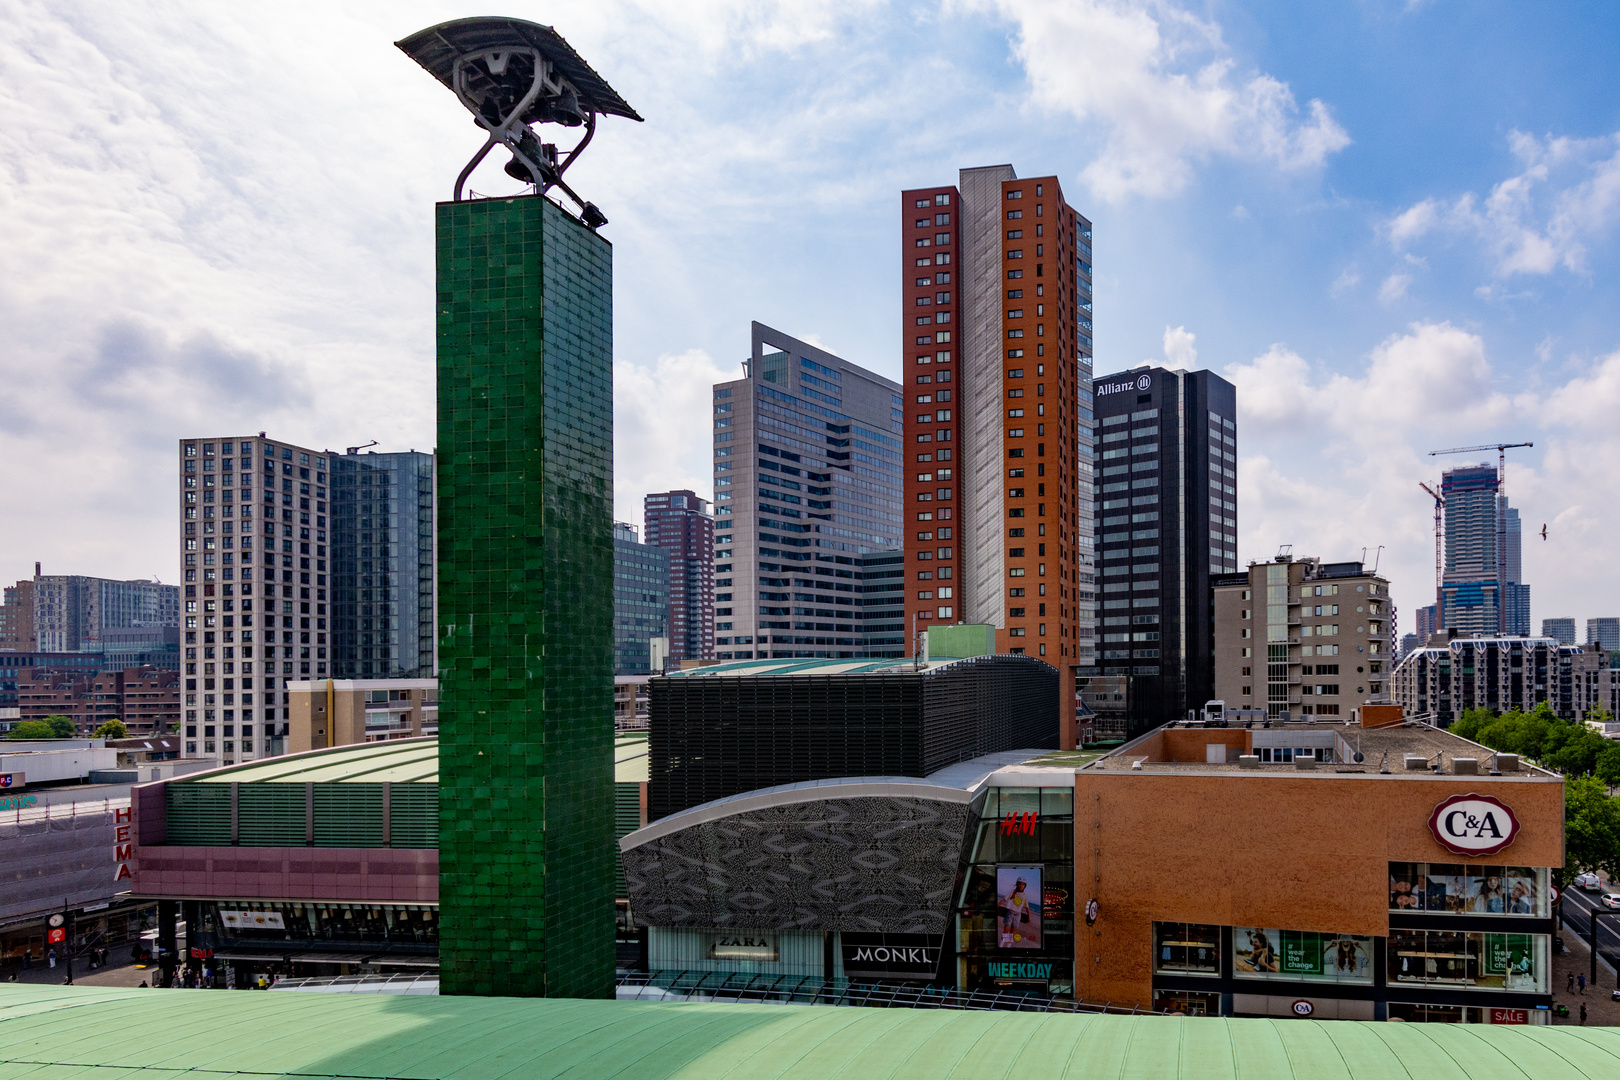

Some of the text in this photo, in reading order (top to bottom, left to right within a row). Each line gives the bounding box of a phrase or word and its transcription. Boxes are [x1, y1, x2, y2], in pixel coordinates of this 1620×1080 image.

[1097, 381, 1134, 397] Allianz
[1000, 811, 1037, 837] H&M
[1445, 810, 1503, 838] C&A
[113, 807, 132, 881] HEMA
[719, 936, 768, 948] ZARA
[852, 947, 932, 963] MONKI
[988, 962, 1053, 979] WEEKDAY
[1287, 961, 1314, 970] change
[1495, 1012, 1523, 1022] SALE
